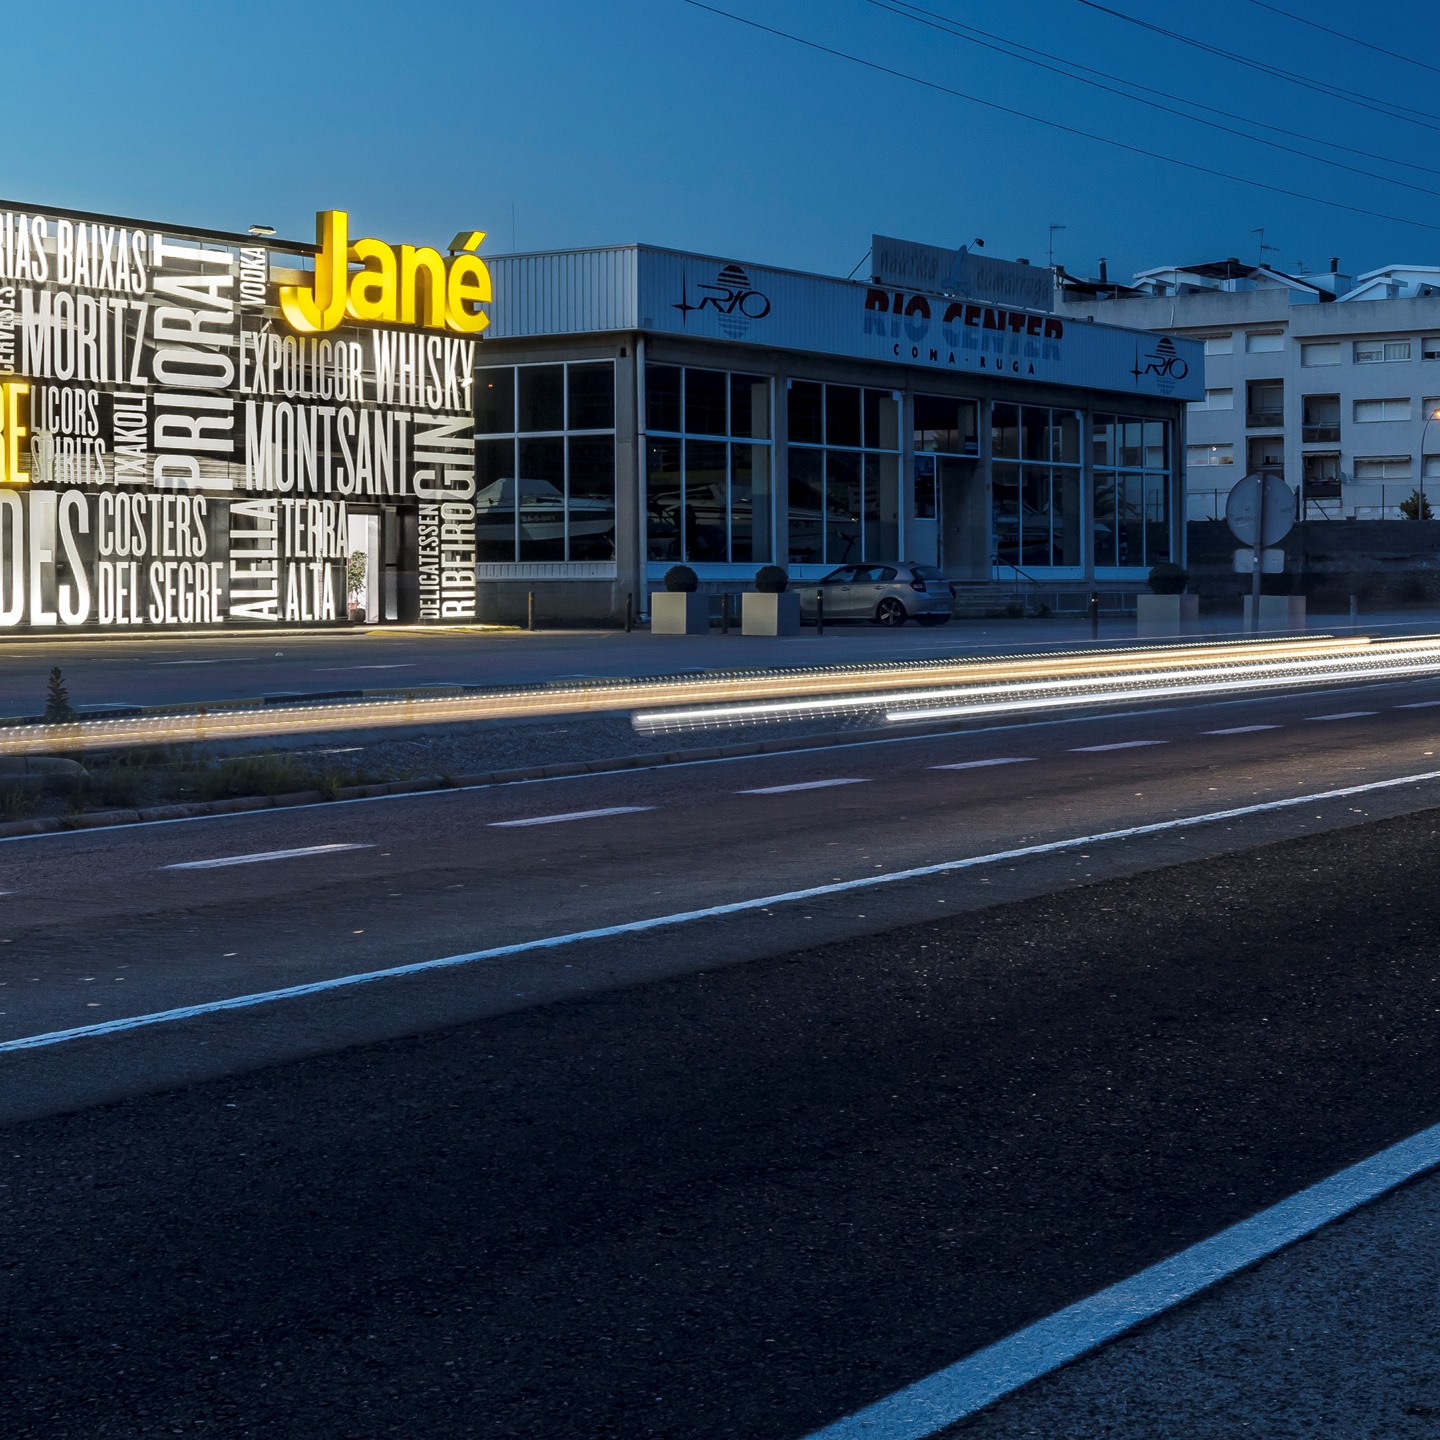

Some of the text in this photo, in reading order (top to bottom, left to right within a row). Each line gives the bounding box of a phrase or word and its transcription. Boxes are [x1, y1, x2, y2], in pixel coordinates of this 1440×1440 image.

[57, 220, 148, 296] BAIXAS
[240, 247, 266, 306] VODKA
[279, 210, 493, 333] Jané
[21, 288, 149, 386] MORITZ
[696, 283, 771, 319] RIO
[863, 288, 1064, 361] RIO CENTER
[153, 234, 235, 490] PRIORAT
[239, 329, 476, 411] EXPOLICOR WHISKY
[1144, 353, 1189, 380] RIO
[30, 384, 99, 437] LICORS
[113, 391, 148, 487] TXAKOLI
[245, 400, 411, 496] MONTSANT
[30, 435, 106, 485] SPIRITS
[412, 413, 476, 501] GIN
[98, 491, 207, 557] COSTERS
[229, 498, 278, 621] ALELLA
[282, 498, 349, 558] TERRA
[418, 503, 440, 620] DELICATESSEN
[440, 502, 476, 618] RIBEIRO
[98, 561, 223, 624] DEL SEGRE
[286, 562, 335, 620] ALTA
